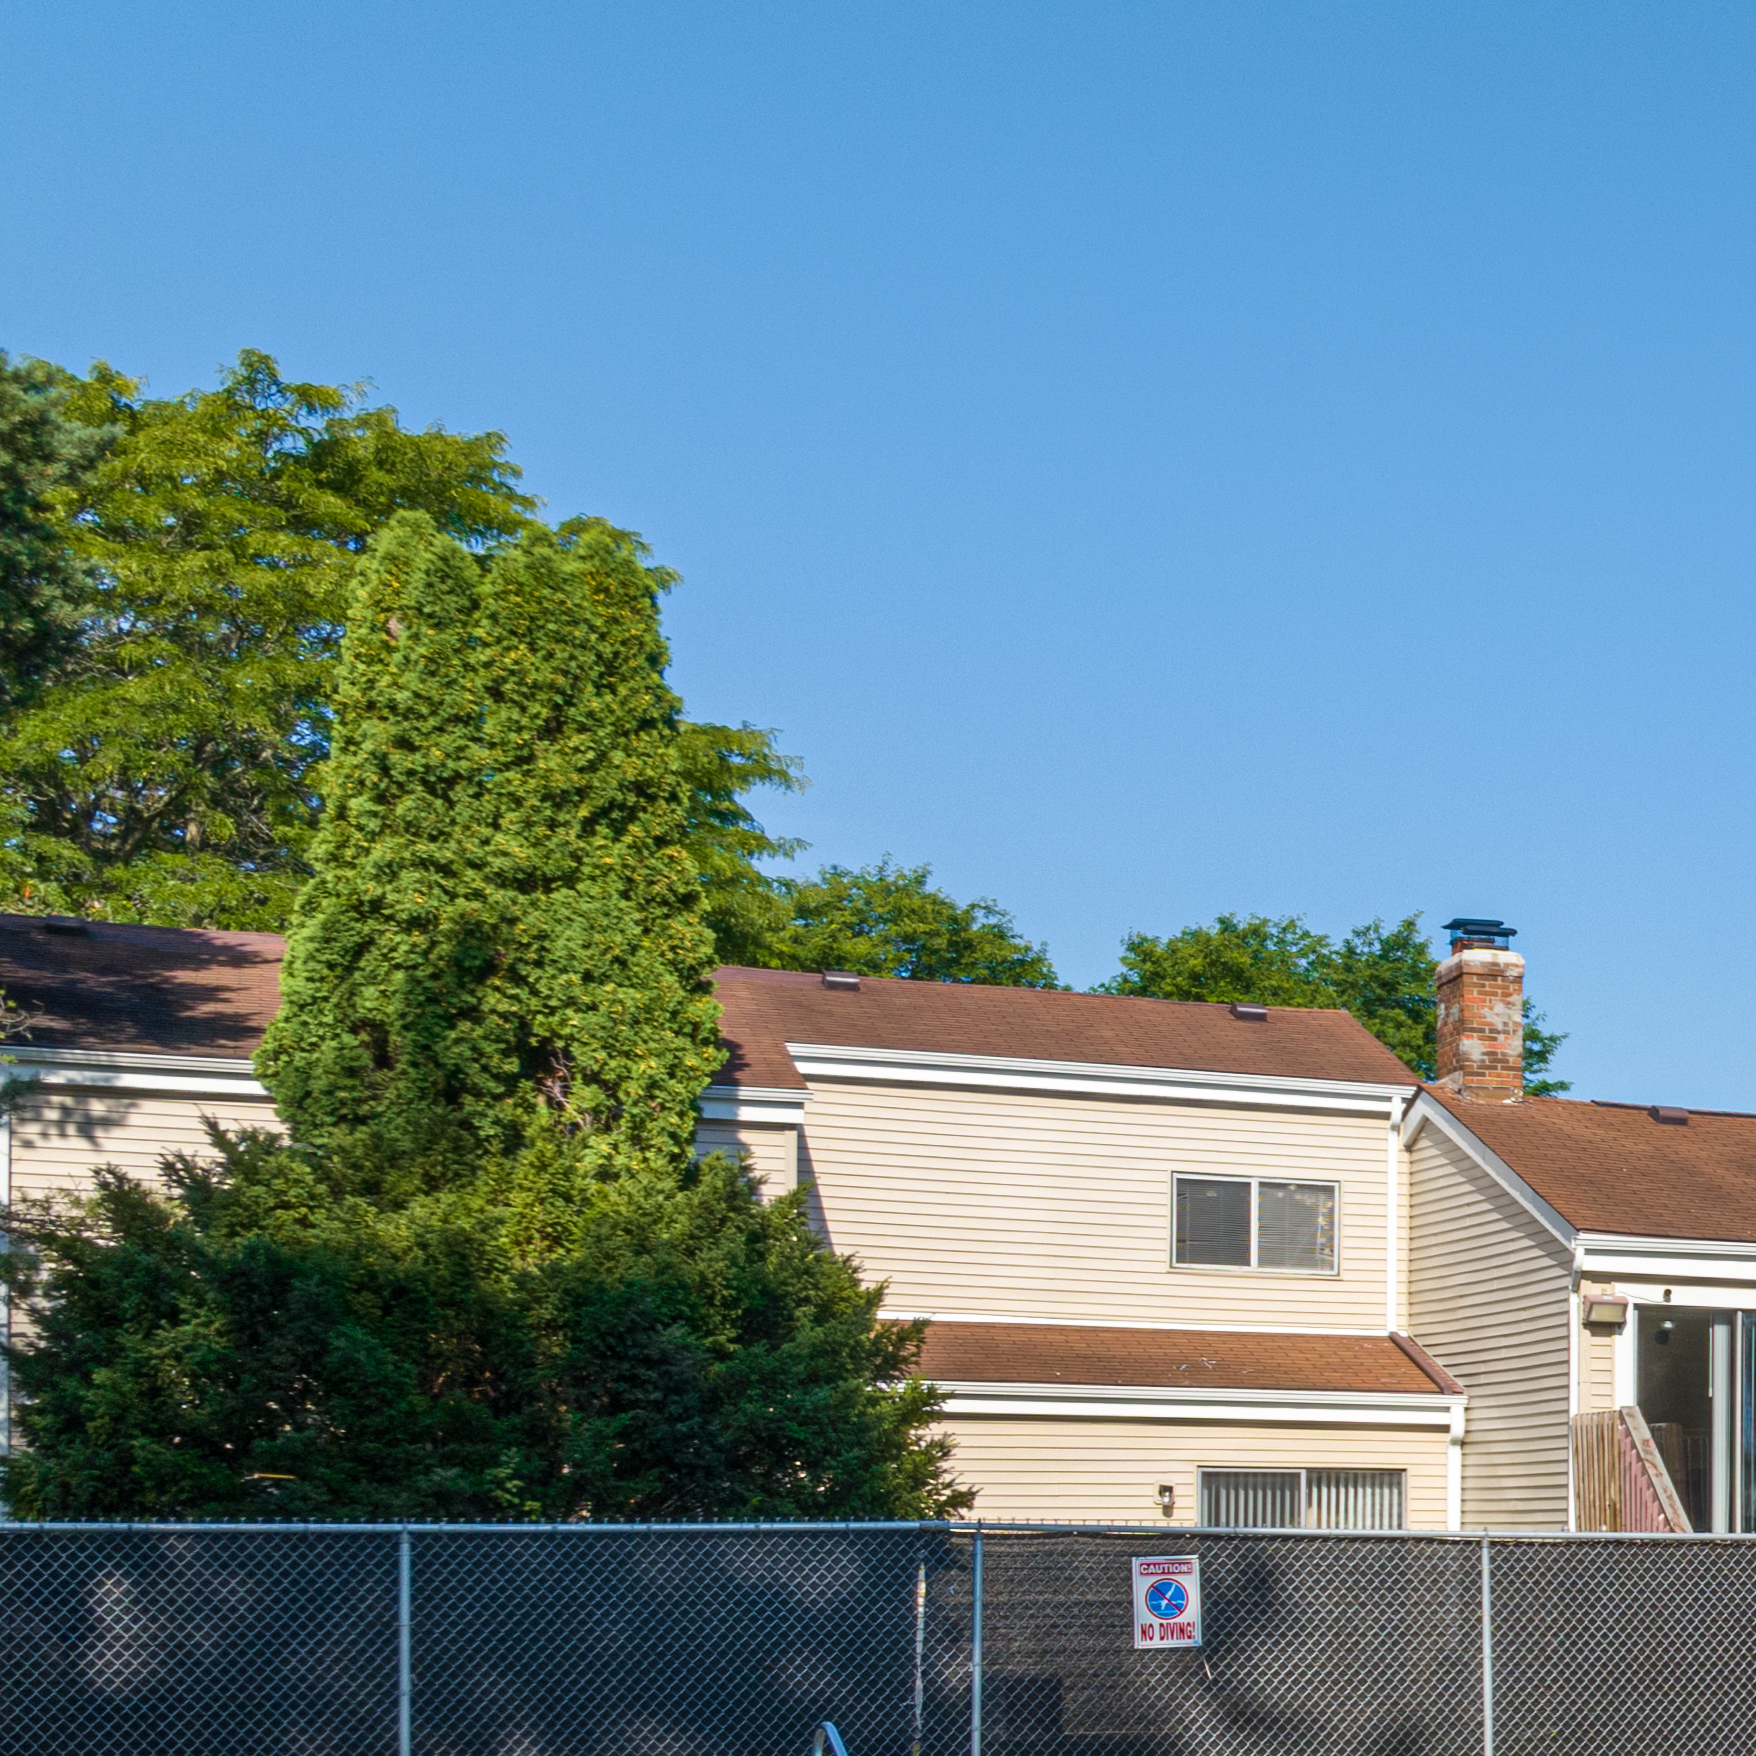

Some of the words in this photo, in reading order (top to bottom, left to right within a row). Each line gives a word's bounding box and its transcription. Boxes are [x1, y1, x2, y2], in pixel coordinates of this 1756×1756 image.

[1140, 1563, 1191, 1574] CAUTION!
[1140, 1622, 1154, 1641] NO
[1159, 1621, 1195, 1641] DIVING!
